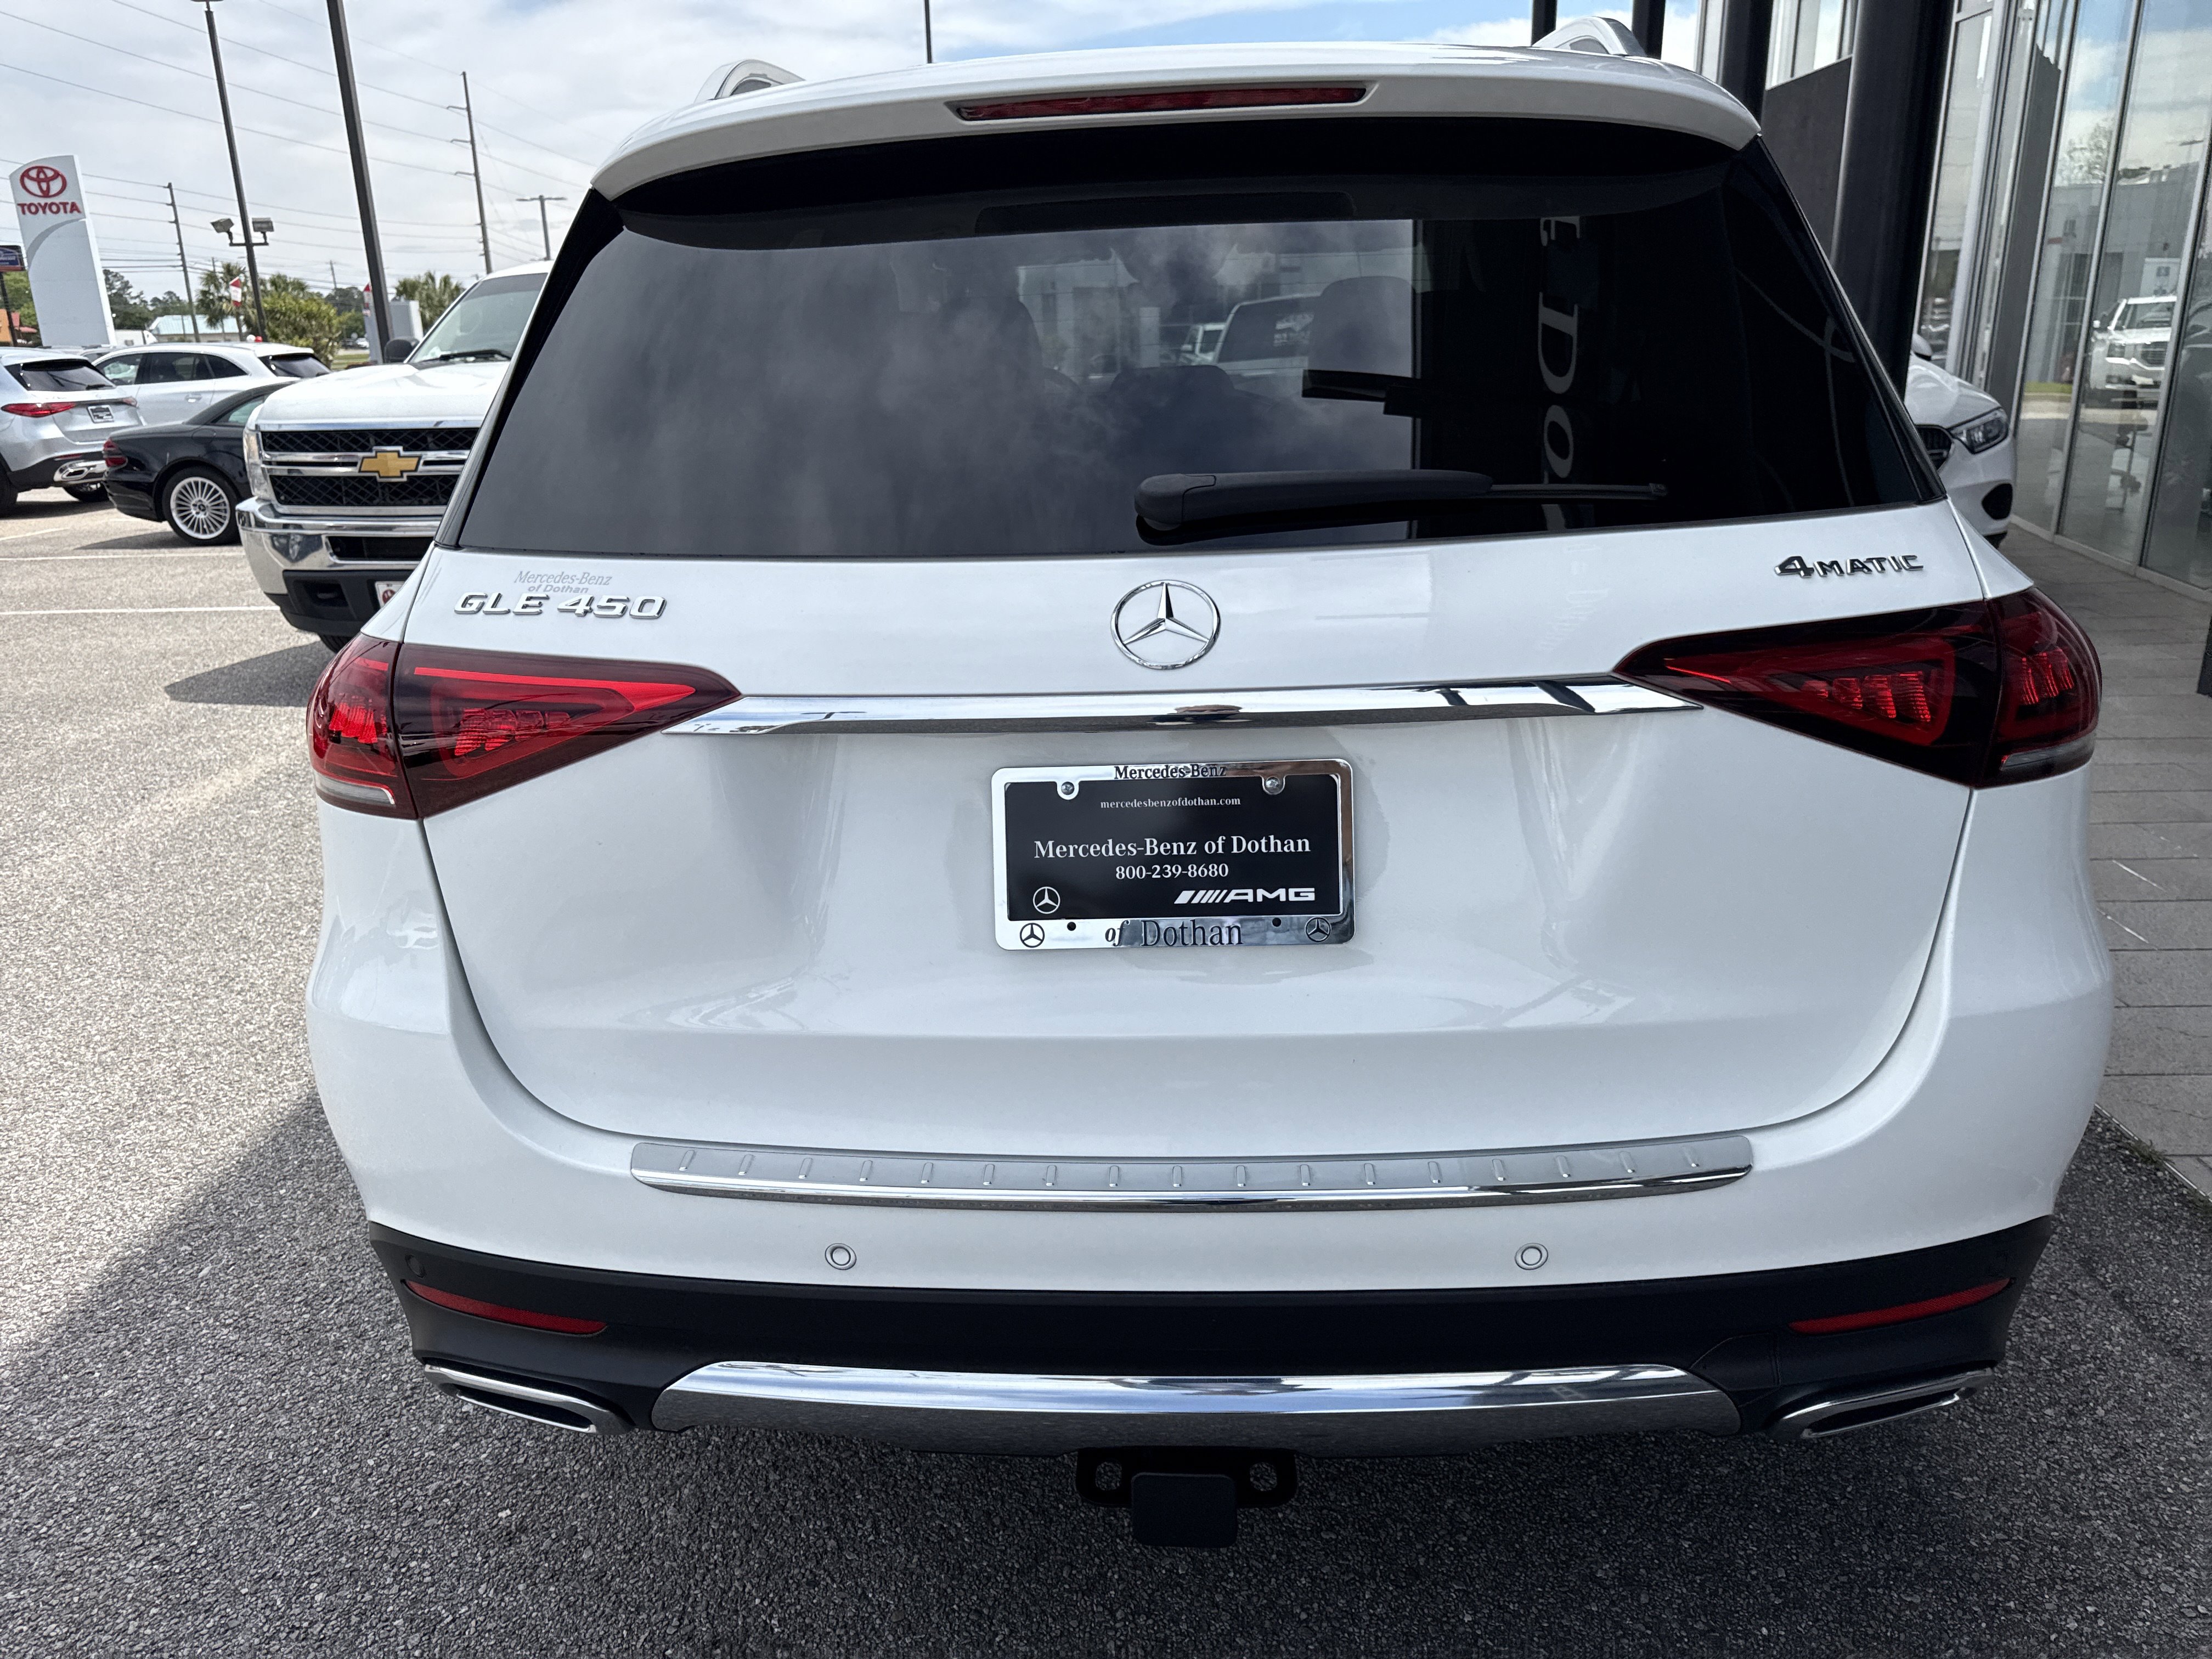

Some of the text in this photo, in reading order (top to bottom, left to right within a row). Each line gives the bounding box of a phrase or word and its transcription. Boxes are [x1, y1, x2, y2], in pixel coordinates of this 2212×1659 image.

[17, 201, 82, 215] TOYOTA
[1774, 555, 1924, 578] 4MATIC
[514, 571, 613, 585] Mercedes-Benz
[528, 584, 589, 594] of Dothan
[454, 592, 667, 619] GLE 450
[1114, 764, 1227, 780] Mercedes-Benz
[1099, 796, 1242, 809] mercedesbenzofdothan.com
[1034, 834, 1311, 859] Mercedes-Benz of Dothan
[1115, 864, 1229, 879] 800-239-8680
[1105, 919, 1244, 947] of Dothan
